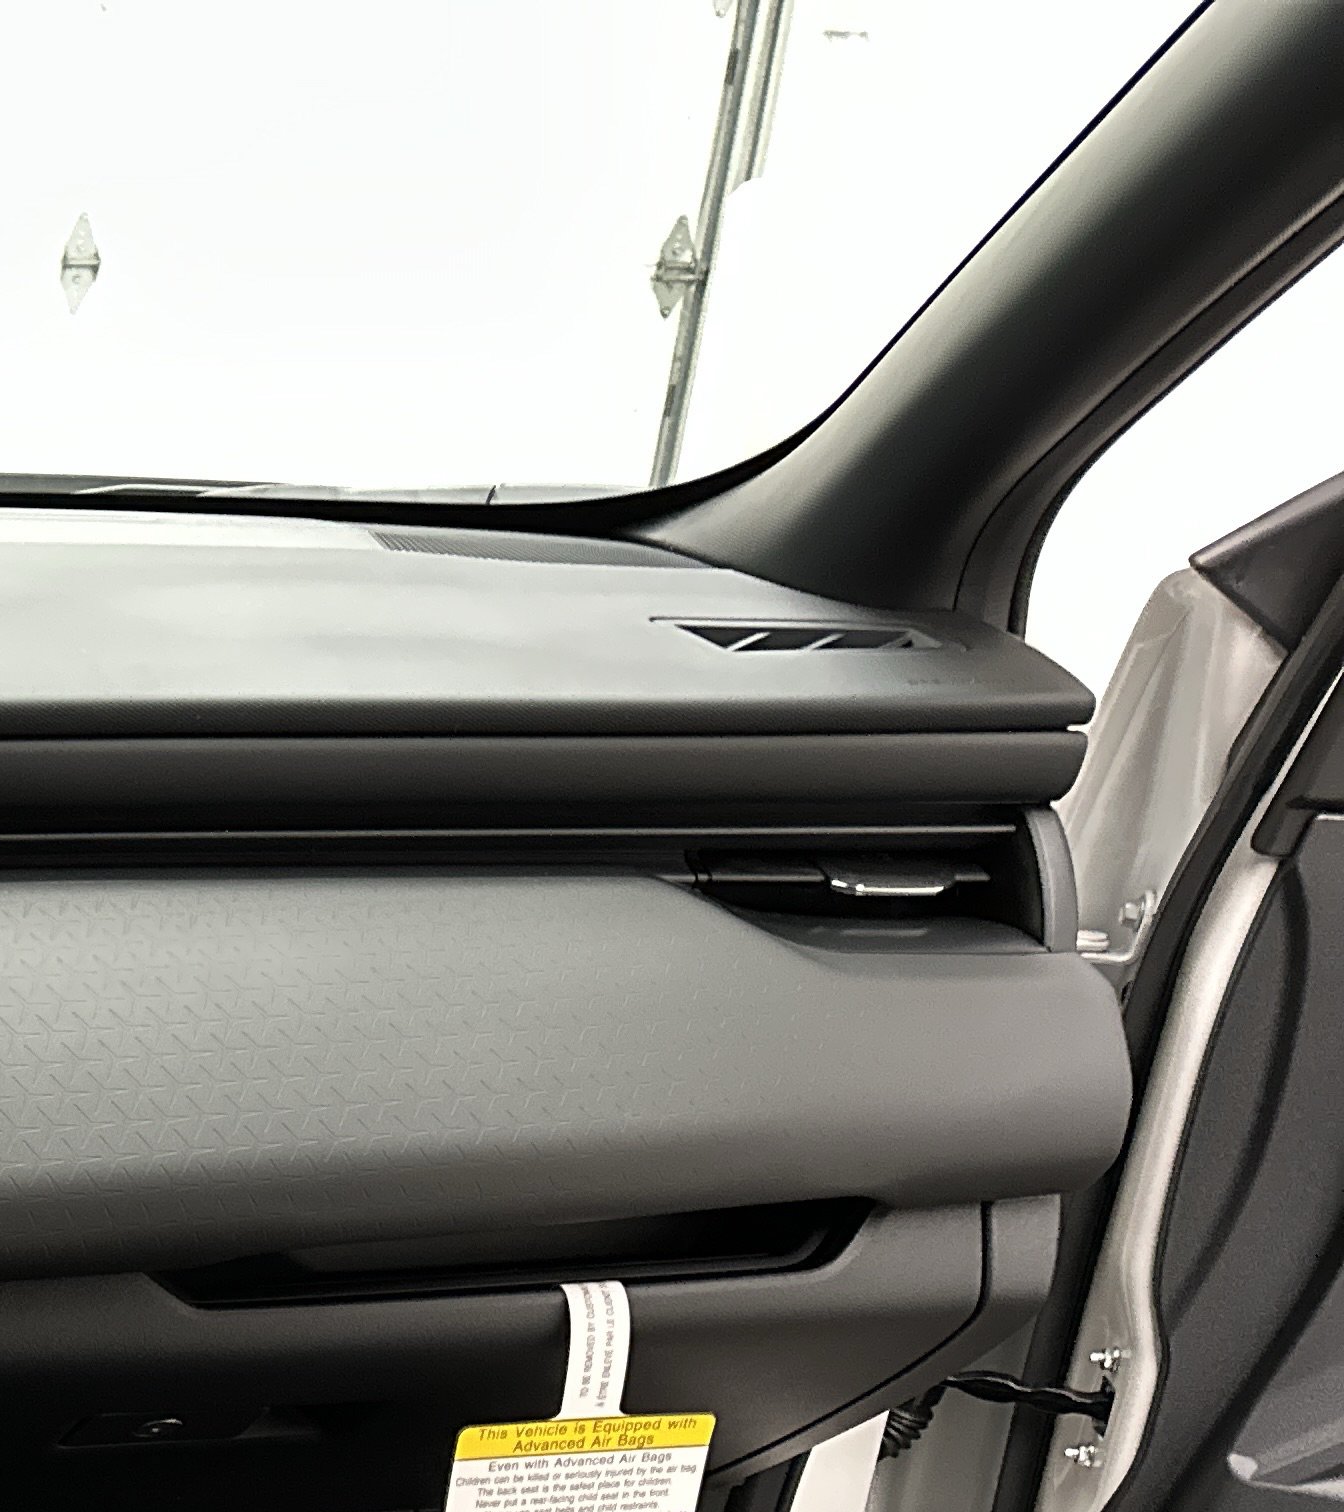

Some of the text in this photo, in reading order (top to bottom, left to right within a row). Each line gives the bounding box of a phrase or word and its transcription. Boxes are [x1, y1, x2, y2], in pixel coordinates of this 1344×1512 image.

[479, 1418, 697, 1441] This Vehicle is Equipped with
[512, 1434, 654, 1453] Advanced Air Bags
[488, 1452, 672, 1472] Even with Advanced Air Bags
[456, 1476, 490, 1487] Children
[494, 1476, 510, 1484] can
[513, 1474, 524, 1483] be
[528, 1473, 550, 1481] killed
[565, 1469, 601, 1479] seriously
[605, 1467, 633, 1478] injured
[636, 1467, 647, 1476] by
[650, 1466, 664, 1474] the
[666, 1465, 678, 1473] air
[478, 1488, 493, 1497] The
[542, 1485, 549, 1493] is
[552, 1484, 566, 1492] the
[622, 1491, 630, 1499] in
[633, 1490, 646, 1498] the
